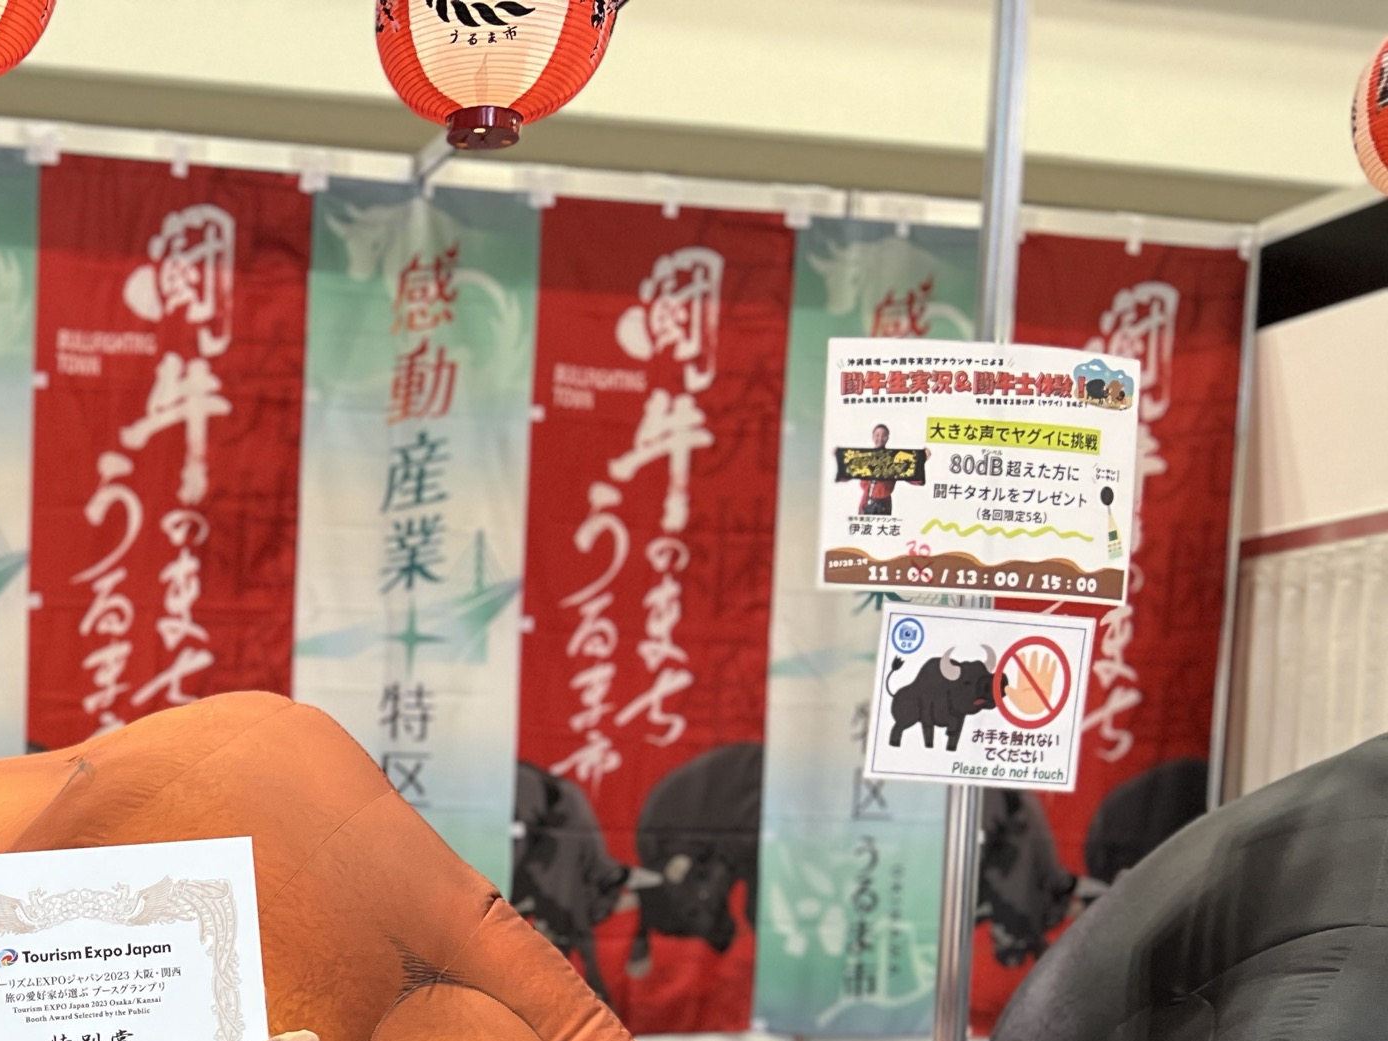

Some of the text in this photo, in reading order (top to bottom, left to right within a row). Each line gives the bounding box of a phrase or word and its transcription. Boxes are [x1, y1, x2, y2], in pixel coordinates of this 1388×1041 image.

[449, 26, 518, 46] うるま市
[930, 423, 1098, 451] 大きな声でヤグイに挑戦
[933, 483, 1087, 507] 闘牛タオルをプレゼント
[971, 729, 1060, 748] お手を触れない
[985, 748, 1044, 763] でください
[952, 762, 1064, 780] Please do not touch
[22, 942, 172, 964] Tourism Expo Japan
[133, 967, 182, 981] 大阪・関西
[5, 982, 165, 1003] 旅の愛好家が選ぶ ブースグランプリ
[13, 996, 162, 1014] Tourism EXPO Japan 2023 Osaka/Kansai
[25, 1015, 47, 1023] Booth
[48, 1012, 73, 1021] Award
[74, 1010, 104, 1020] Selected
[105, 1010, 114, 1019] by
[127, 1007, 150, 1016] Public
